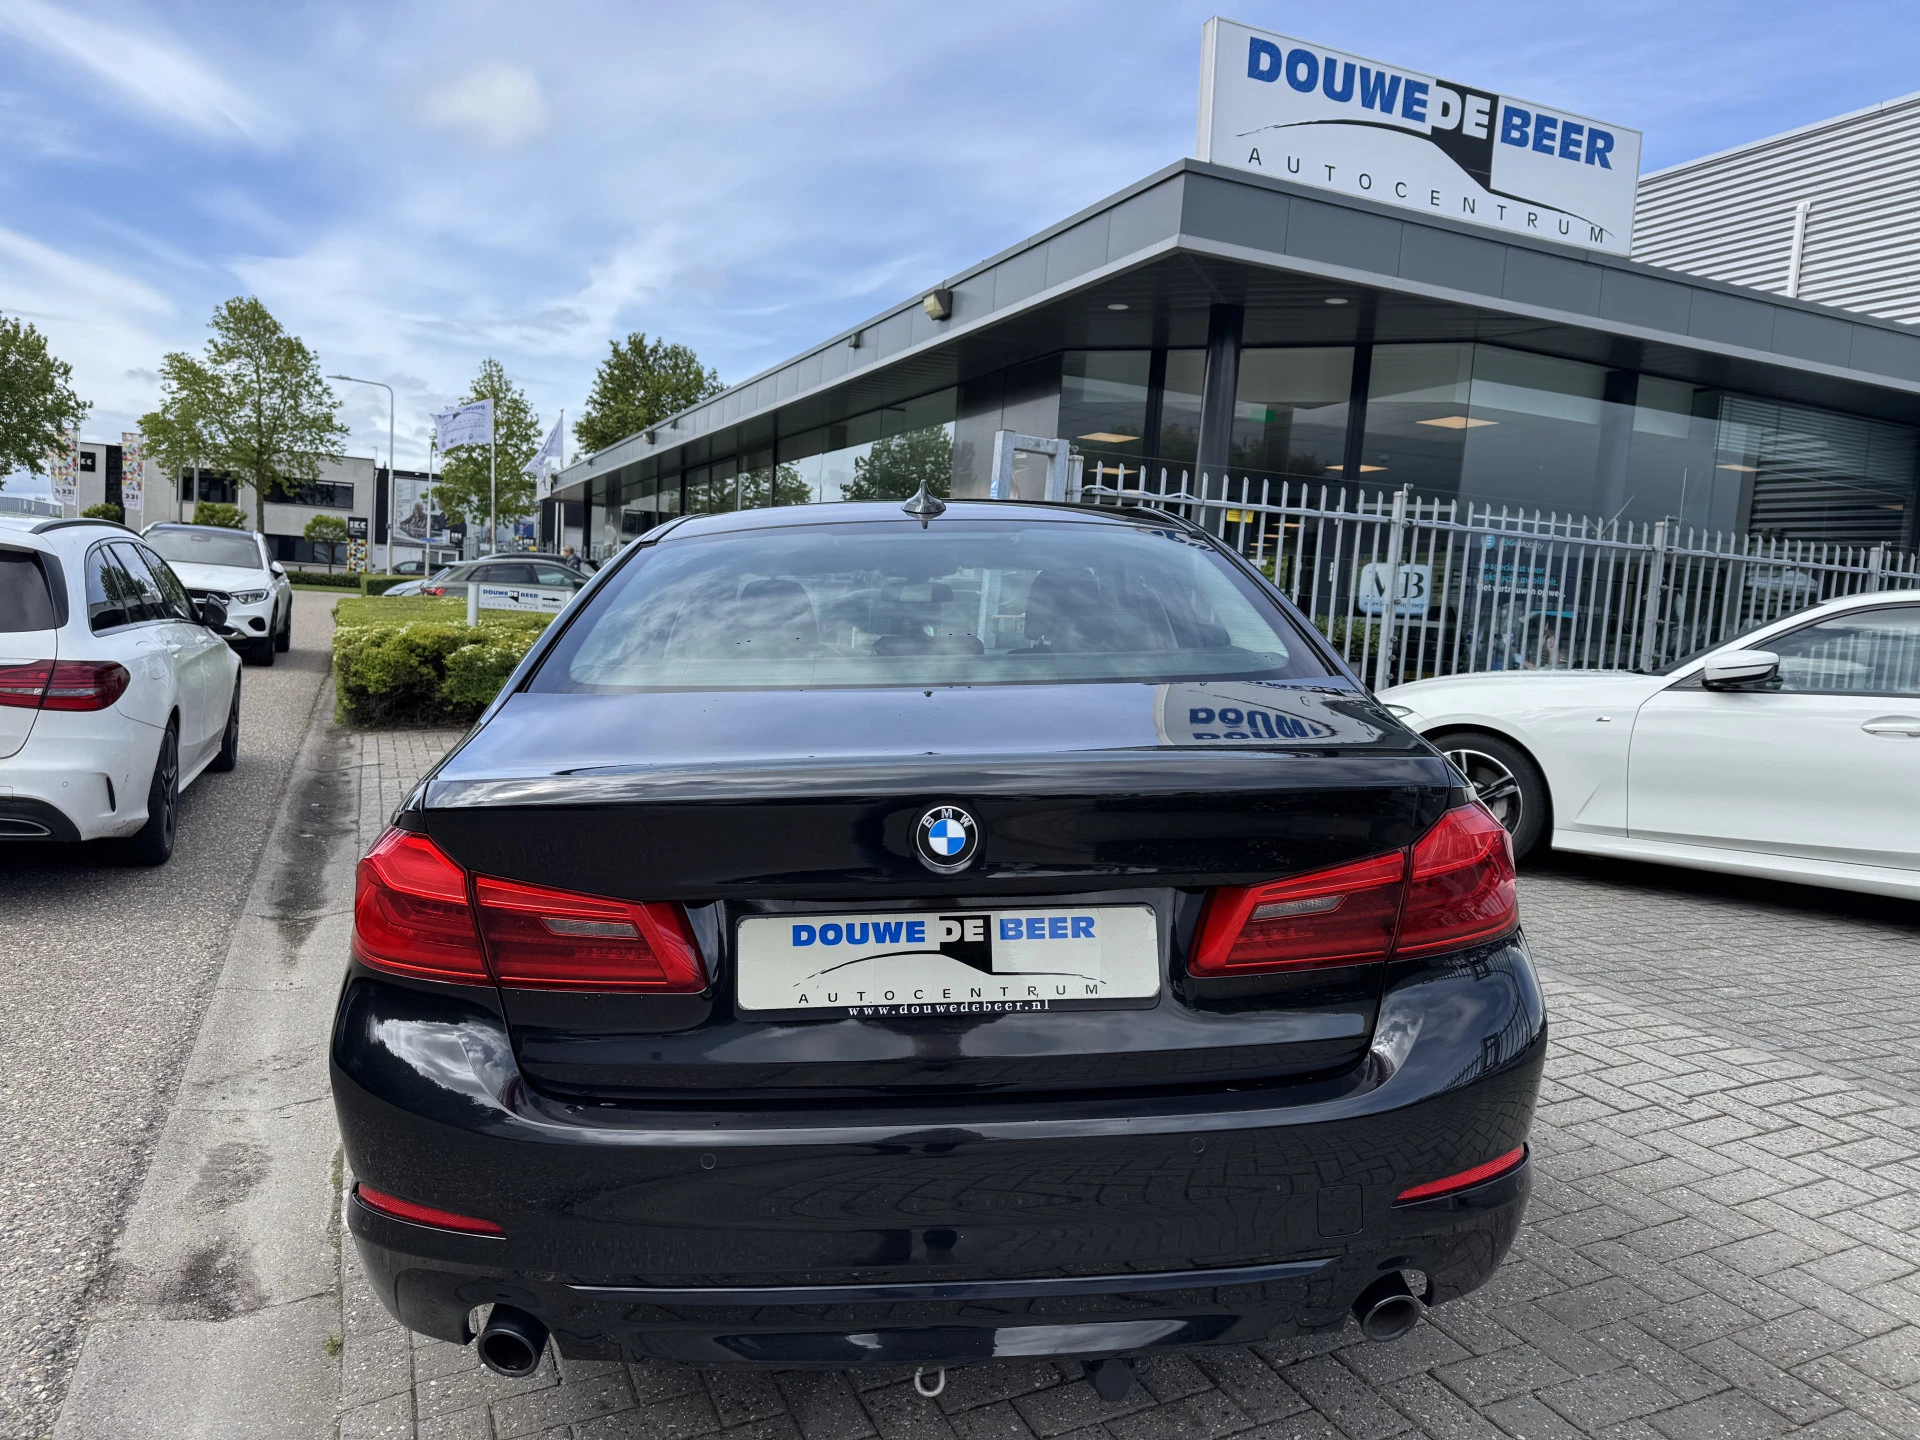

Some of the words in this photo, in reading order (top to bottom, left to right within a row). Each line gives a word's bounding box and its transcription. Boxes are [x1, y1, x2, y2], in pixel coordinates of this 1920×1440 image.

[1247, 36, 1430, 124] DOUWE
[1433, 84, 1491, 140] DE
[1500, 104, 1615, 170] BEER
[1248, 147, 1604, 244] AUTOCENTRUM
[1490, 563, 1526, 573] speciast
[1493, 585, 1536, 596] vertruwn
[1548, 590, 1566, 600] we.
[922, 808, 973, 829] BMW
[792, 921, 926, 947] DOUWE
[937, 919, 984, 943] DE
[1000, 916, 1096, 940] BEER
[798, 984, 1098, 1003] AUTOCENTRUM
[848, 1000, 1050, 1016] www.douwedebeer.nl
